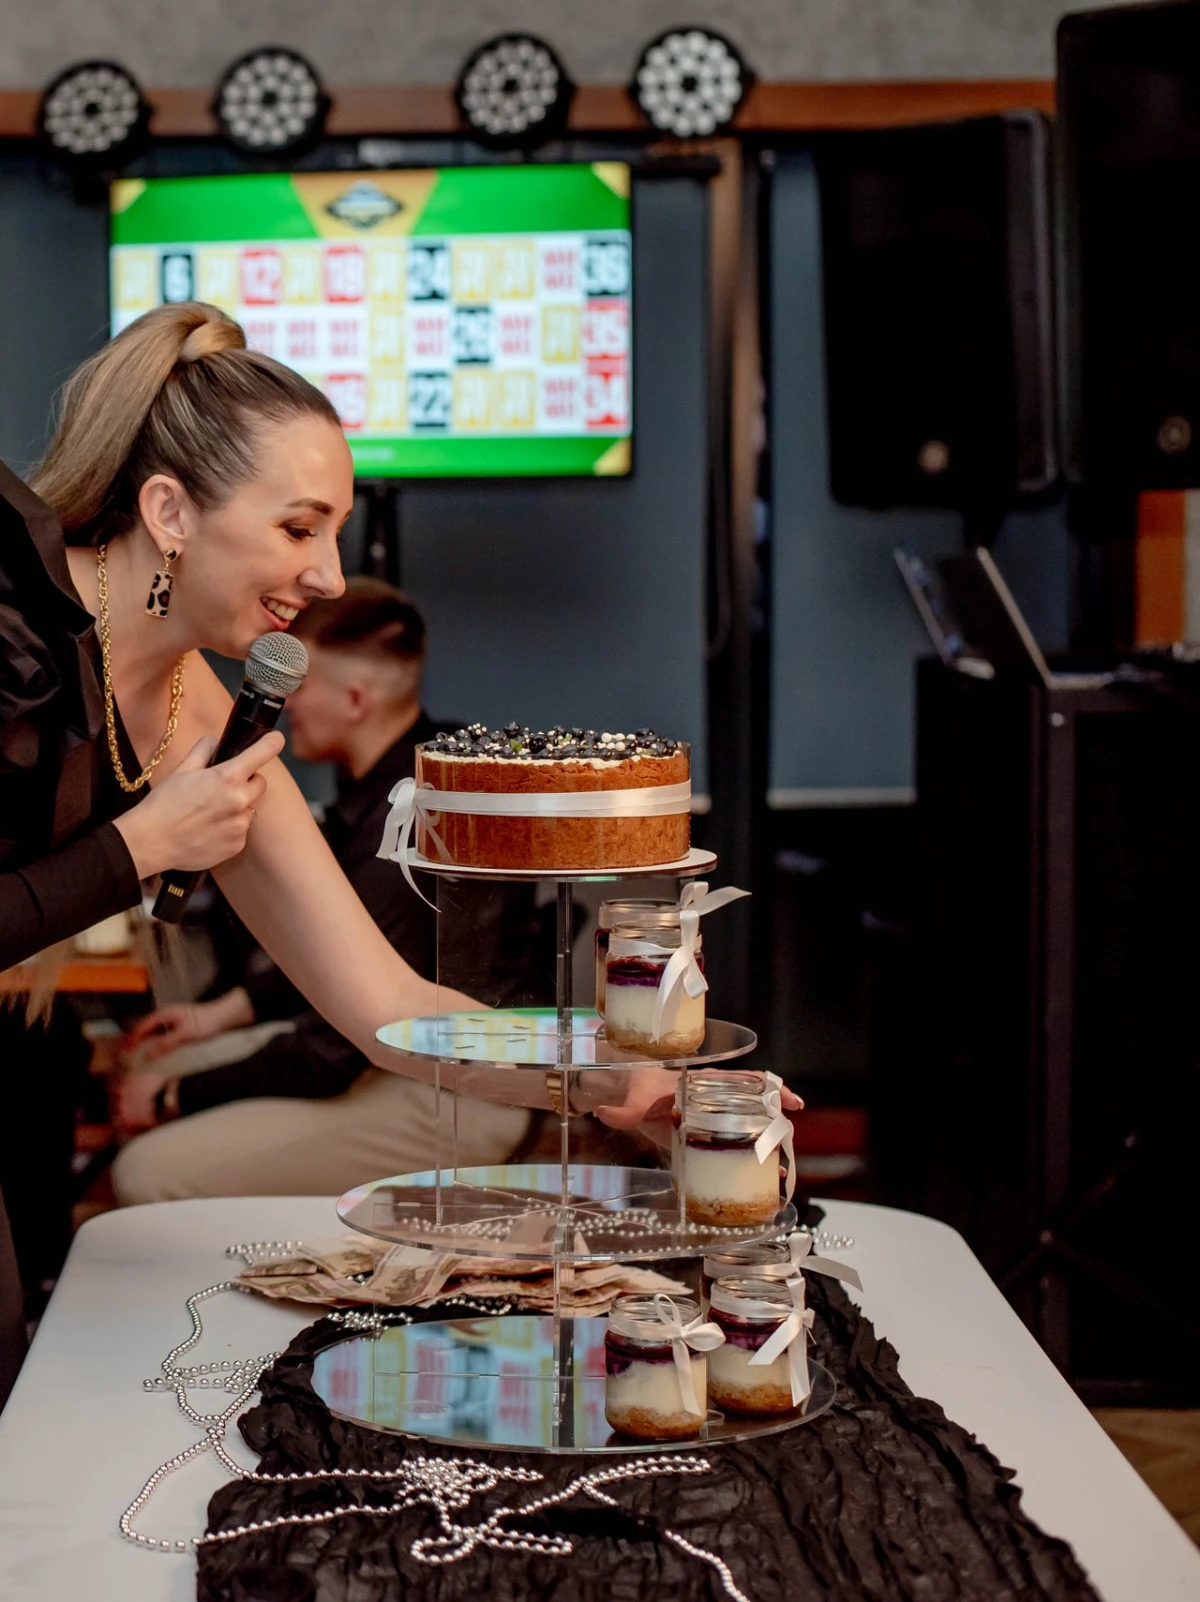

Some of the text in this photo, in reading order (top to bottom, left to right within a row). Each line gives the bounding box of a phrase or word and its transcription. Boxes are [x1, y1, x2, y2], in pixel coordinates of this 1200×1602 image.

[243, 255, 281, 300] 12
[409, 248, 449, 298] 24
[409, 376, 450, 424] 22
[584, 374, 629, 423] 34
